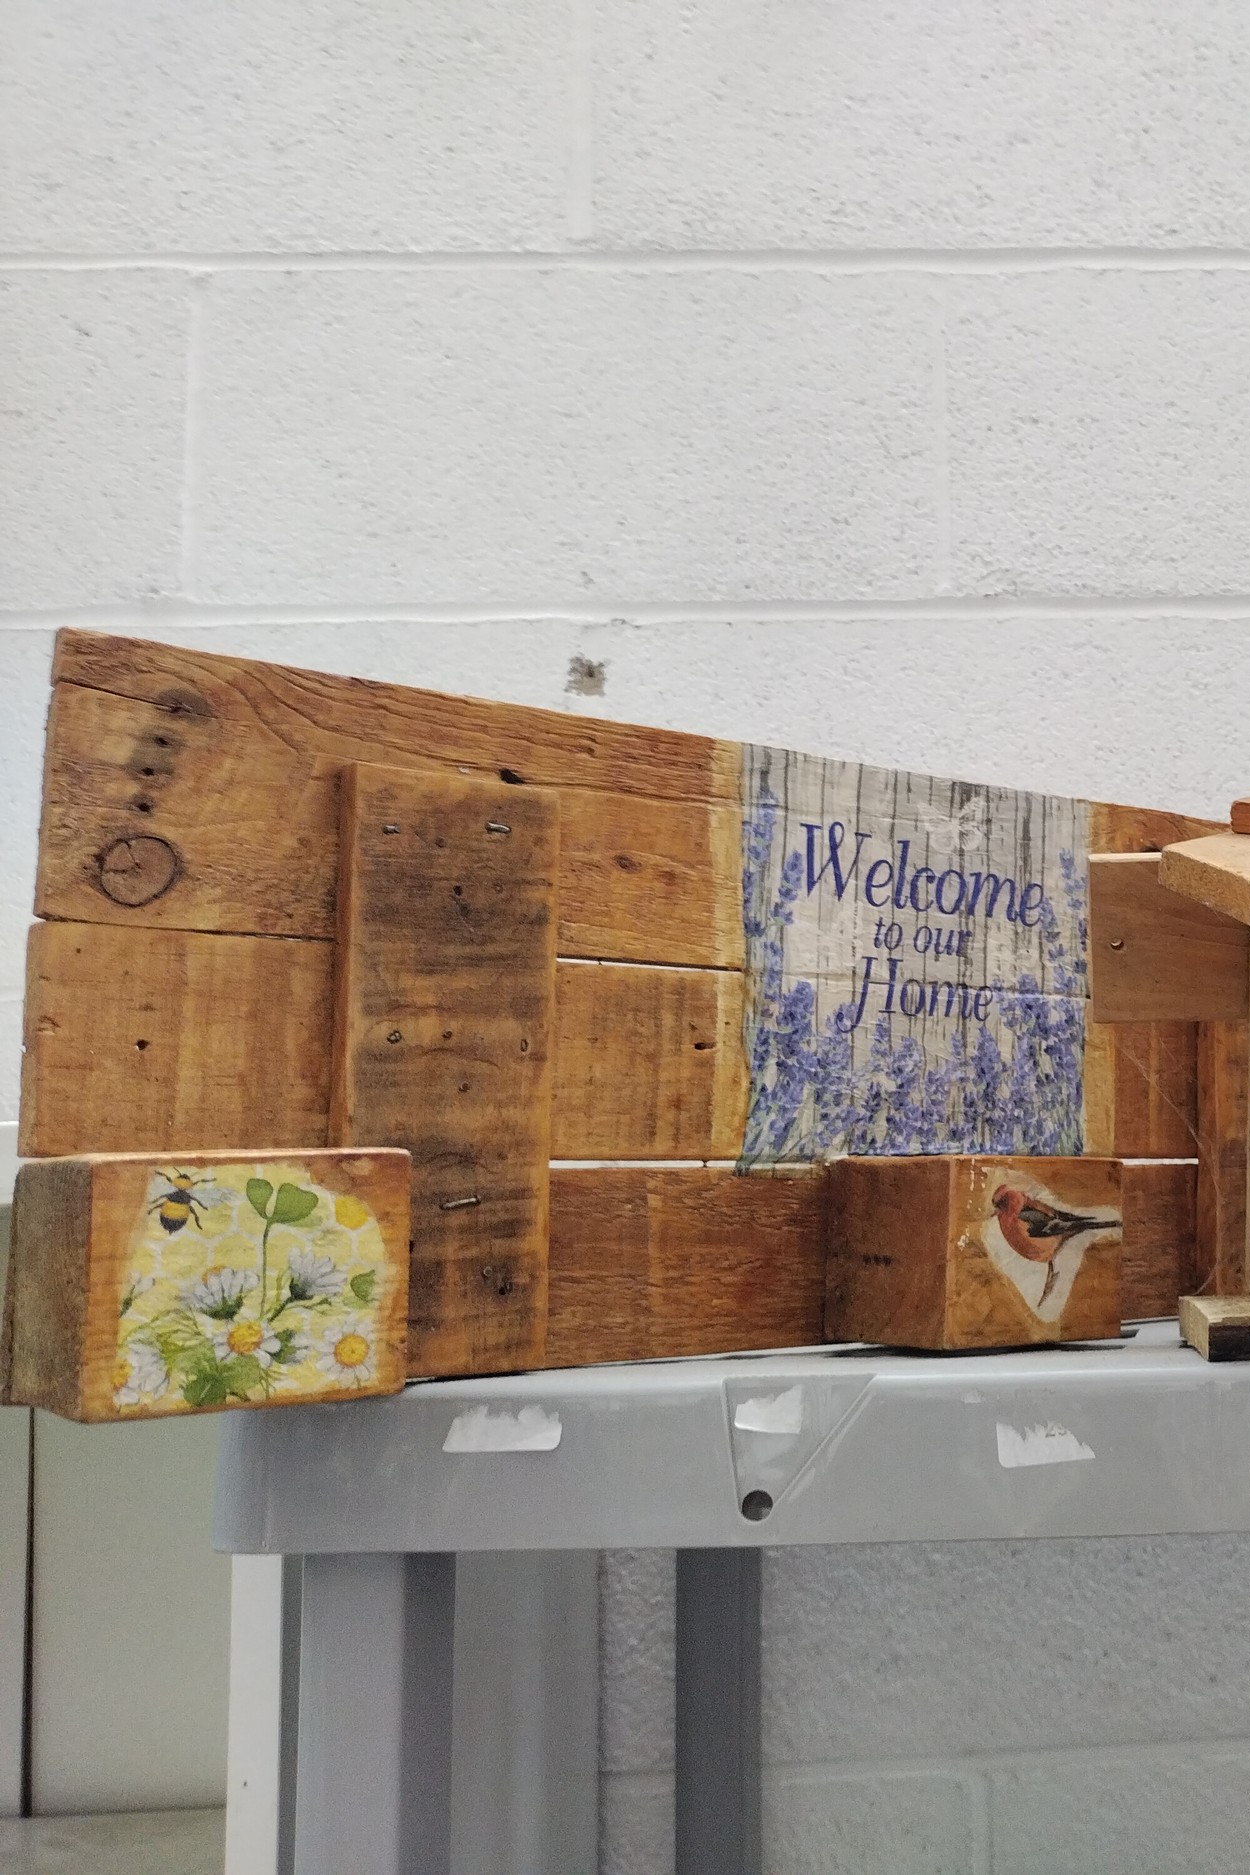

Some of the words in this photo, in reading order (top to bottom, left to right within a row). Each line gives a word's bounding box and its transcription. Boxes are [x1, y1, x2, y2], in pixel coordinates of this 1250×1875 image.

[800, 821, 1044, 927] Welcome
[873, 916, 904, 951] to
[913, 925, 974, 957] our
[836, 956, 993, 1033] Home
